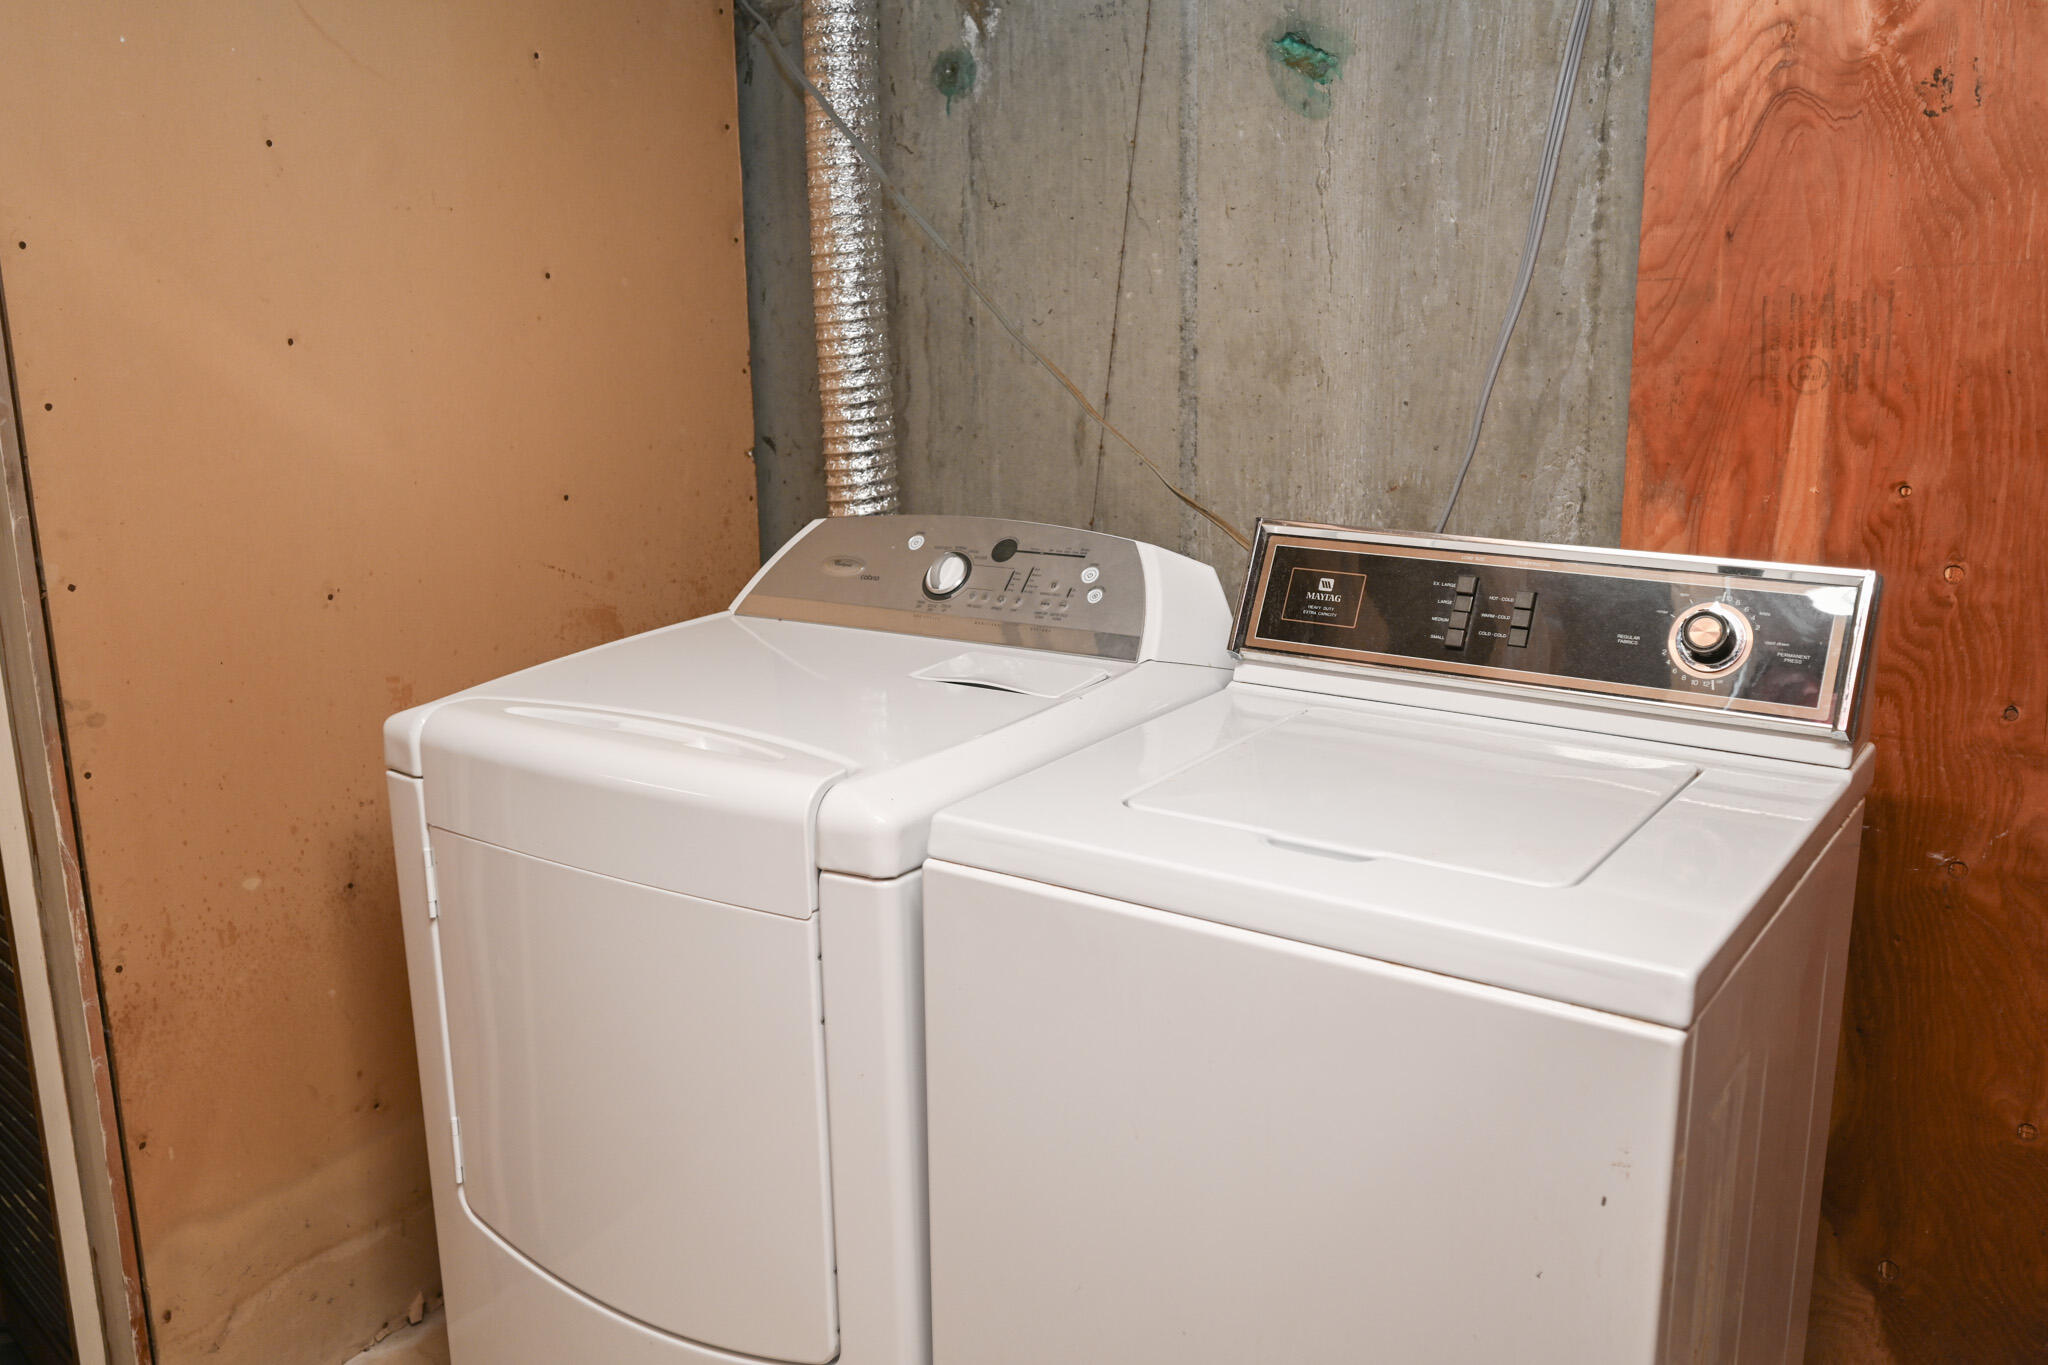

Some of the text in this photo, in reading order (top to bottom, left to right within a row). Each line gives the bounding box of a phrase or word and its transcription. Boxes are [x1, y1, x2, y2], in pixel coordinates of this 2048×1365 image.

[1305, 591, 1342, 603] MAYTAG
[1661, 648, 1667, 656] 2
[1776, 652, 1811, 660] PERMANENT
